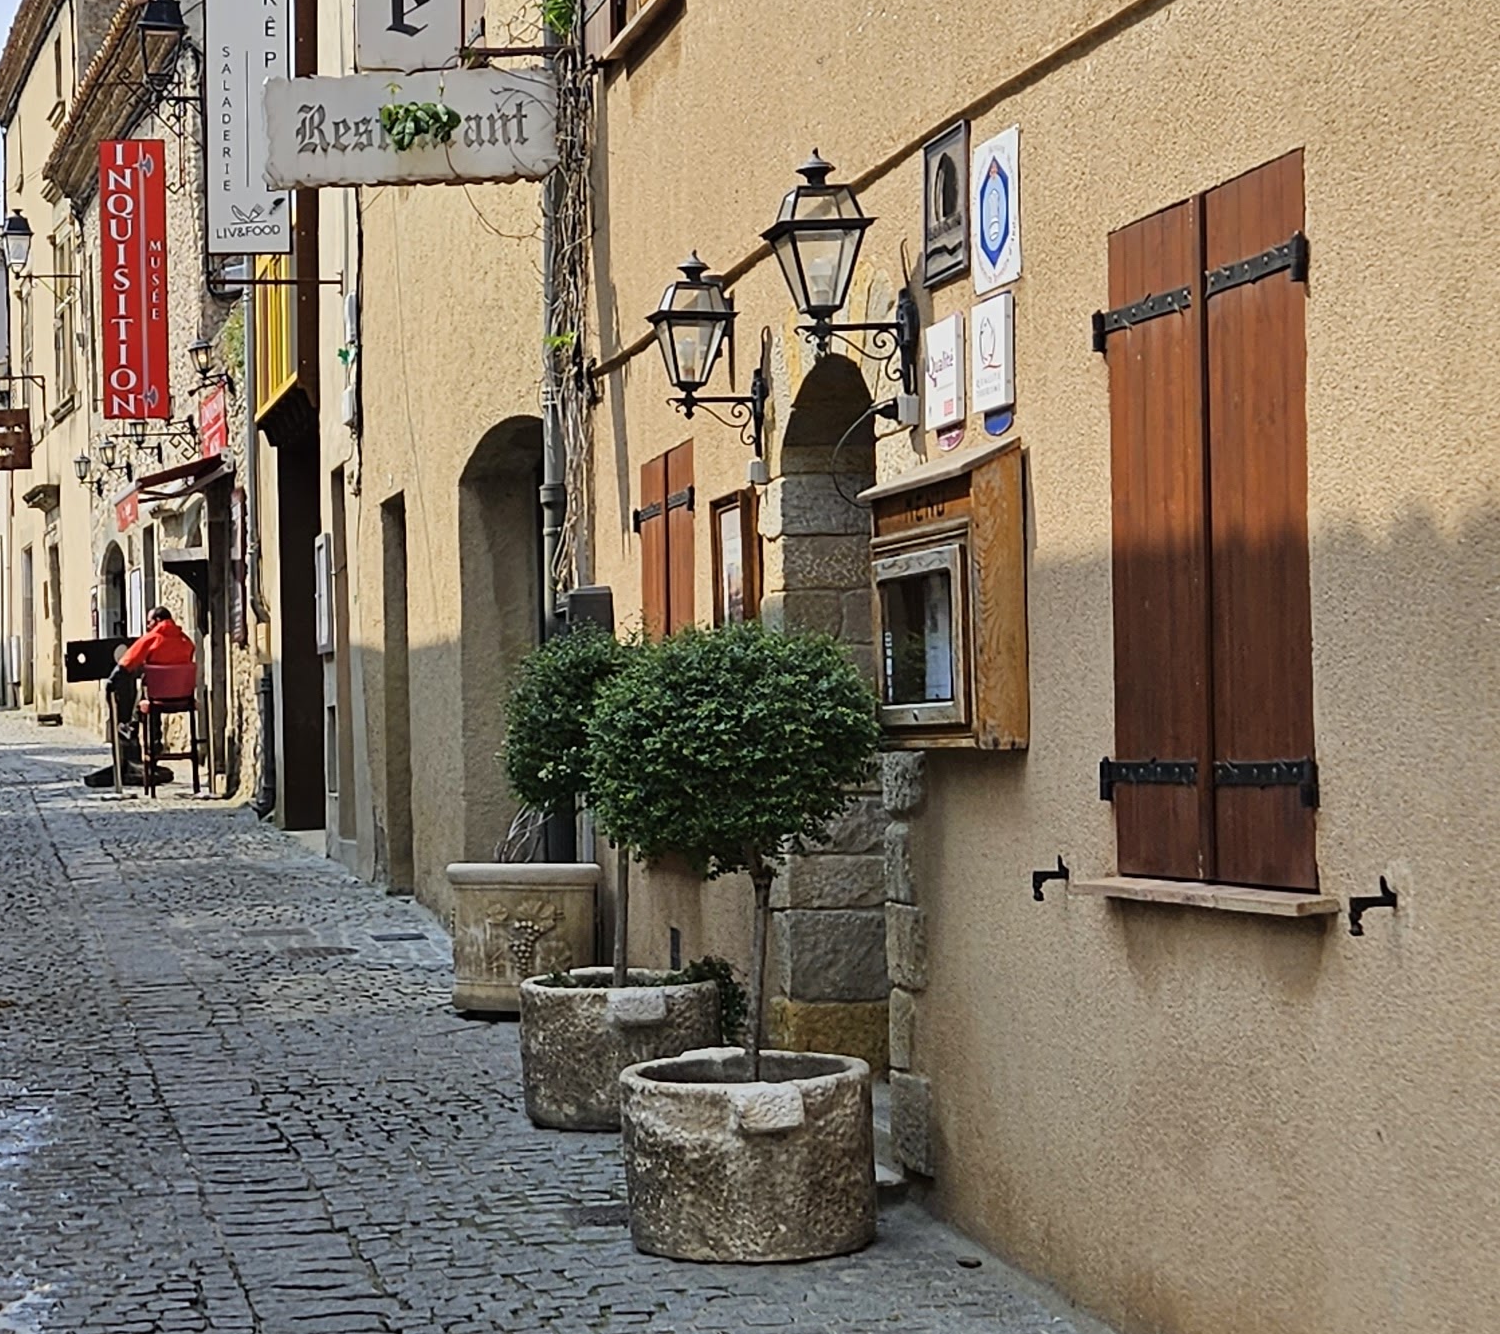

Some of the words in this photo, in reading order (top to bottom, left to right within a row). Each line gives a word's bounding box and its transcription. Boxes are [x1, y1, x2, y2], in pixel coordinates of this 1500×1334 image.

[221, 46, 232, 192] SALADERIE
[106, 143, 137, 416] INQUISITION
[149, 240, 162, 320] MUSÉE
[216, 224, 280, 239] LIV&FOOD
